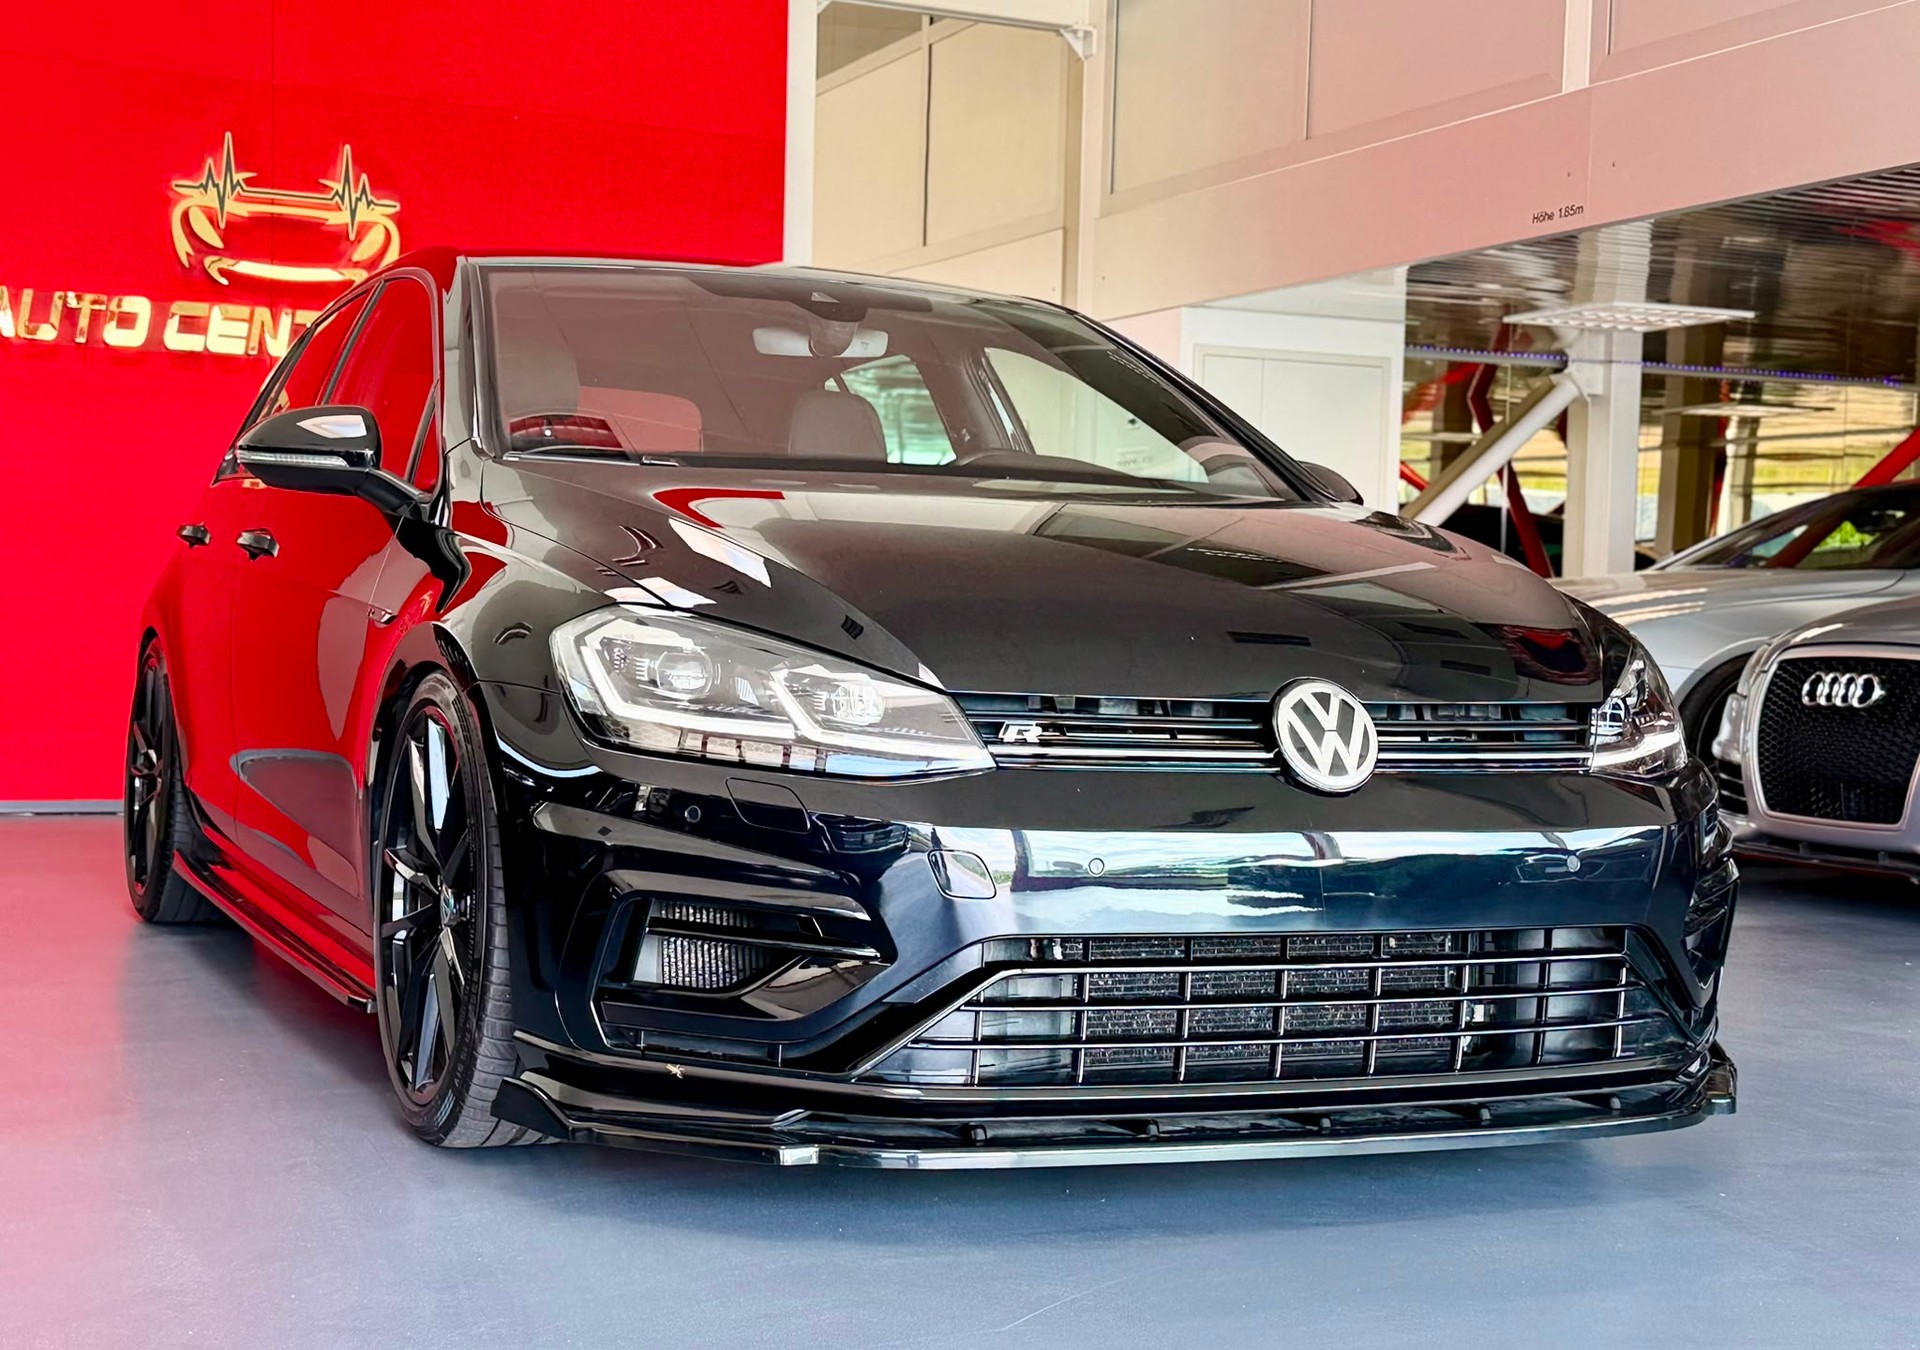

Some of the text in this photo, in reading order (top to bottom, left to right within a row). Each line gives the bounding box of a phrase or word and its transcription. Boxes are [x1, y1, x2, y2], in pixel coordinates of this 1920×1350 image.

[1532, 211, 1554, 224] Höhe
[1000, 722, 1042, 743] R
[1279, 683, 1373, 786] VW
